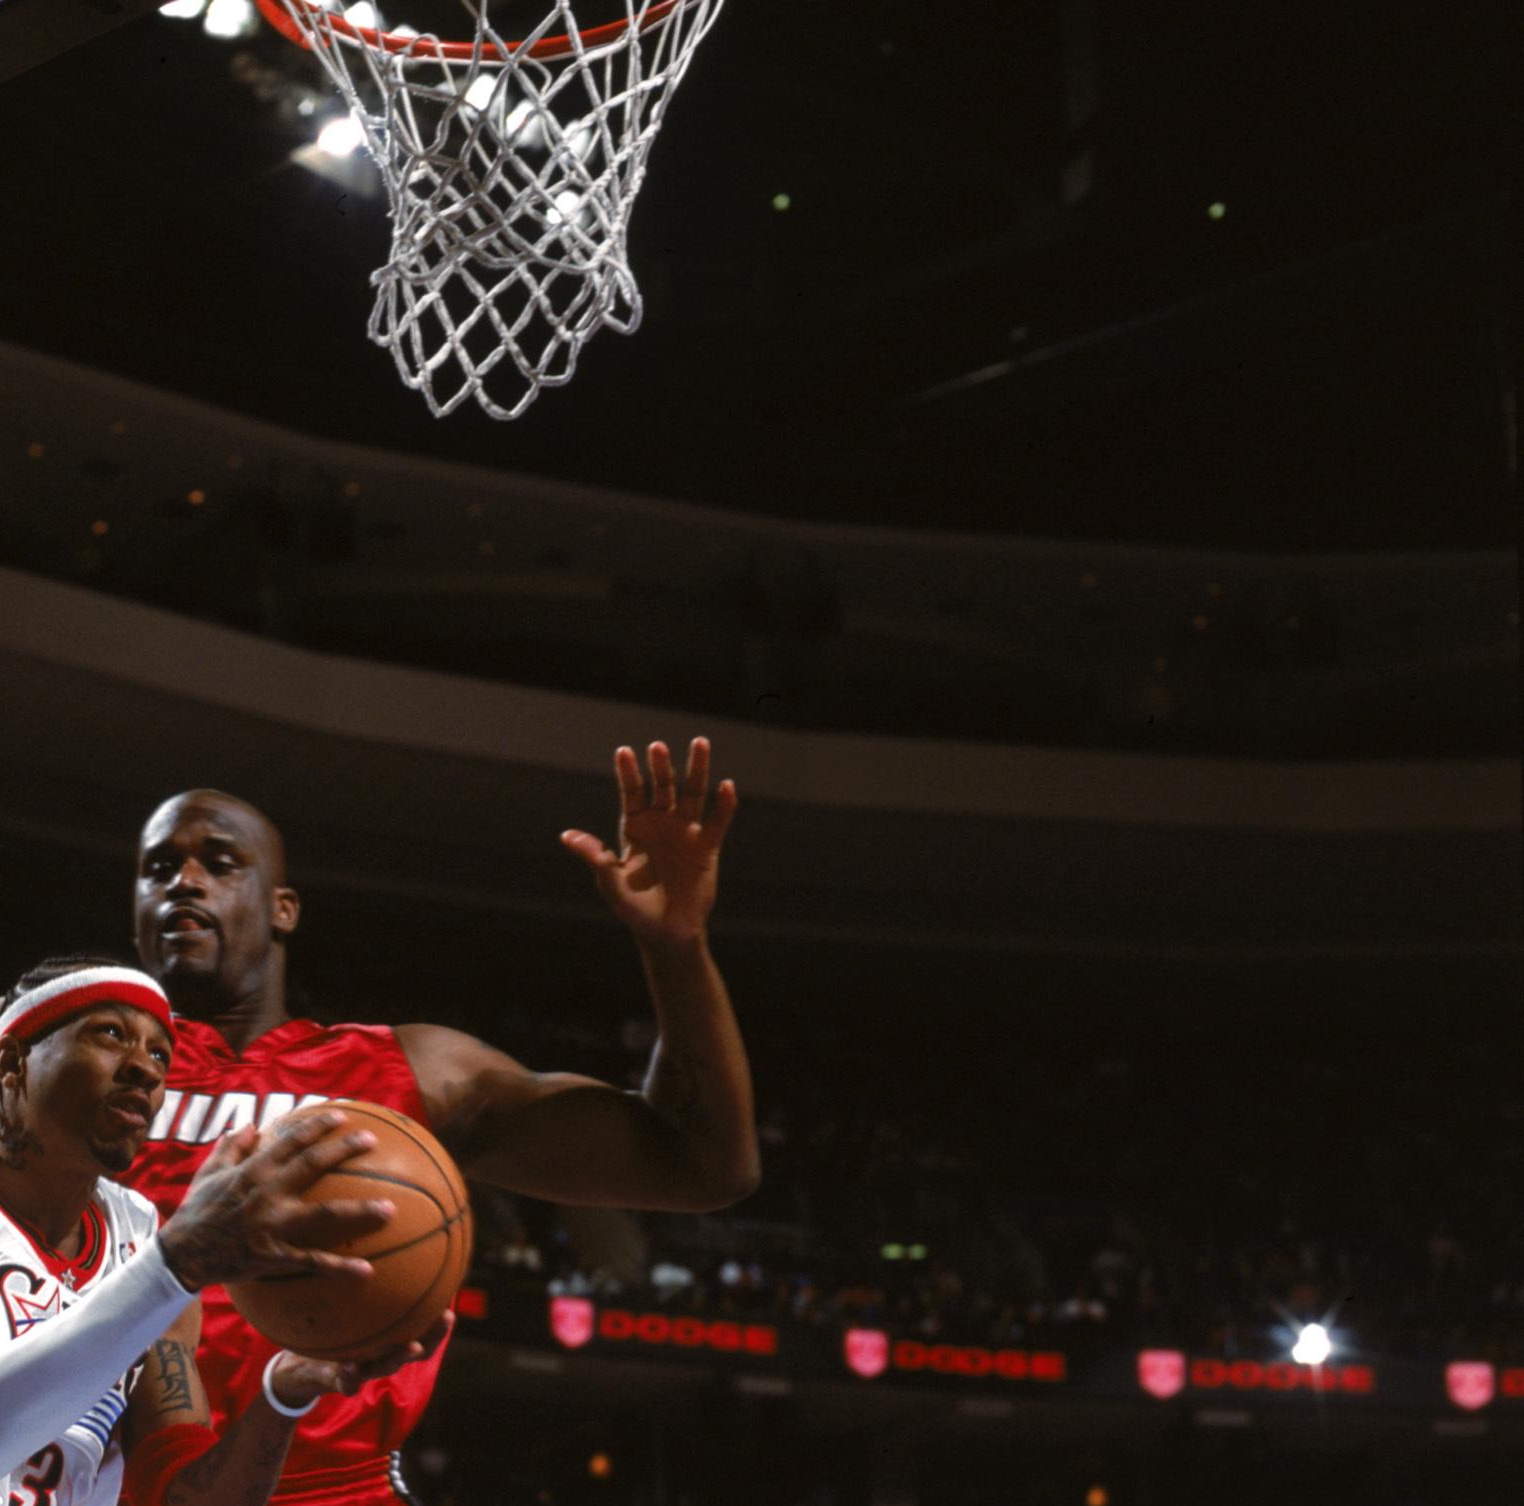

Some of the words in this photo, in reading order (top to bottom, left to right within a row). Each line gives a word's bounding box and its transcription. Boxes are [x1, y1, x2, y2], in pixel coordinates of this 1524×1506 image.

[598, 1309, 777, 1354] DODGE
[894, 1341, 1065, 1380] DODGE
[1189, 1359, 1373, 1392] DODGE
